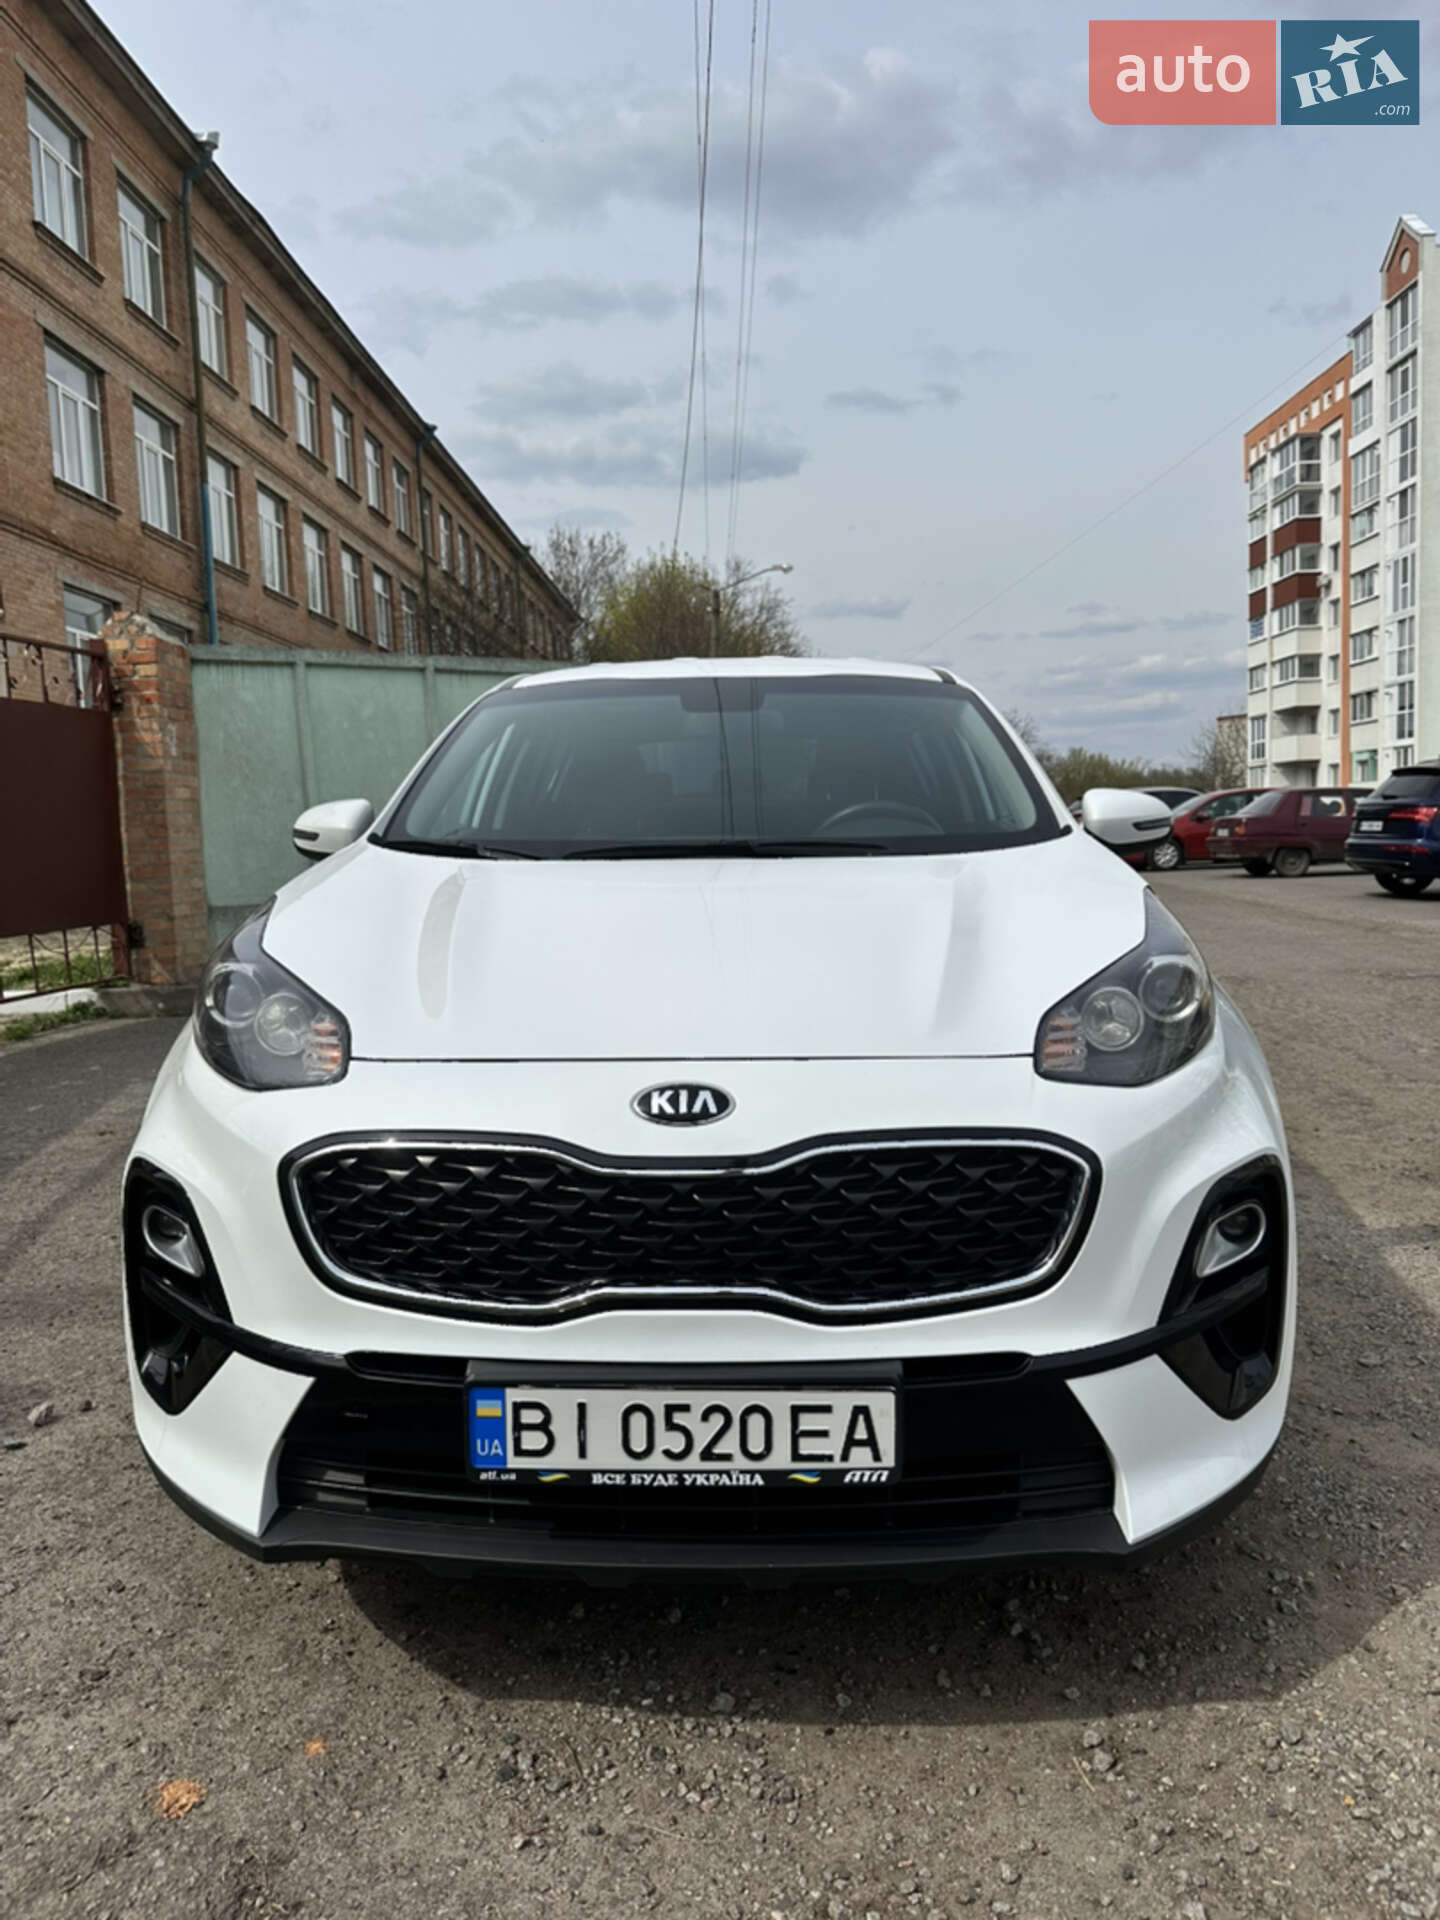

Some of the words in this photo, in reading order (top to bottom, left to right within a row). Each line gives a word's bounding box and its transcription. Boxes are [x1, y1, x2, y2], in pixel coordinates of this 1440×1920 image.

[650, 1089, 717, 1114] KIA
[476, 1438, 503, 1457] UA
[592, 1473, 626, 1485] ВСЕ
[631, 1473, 679, 1487] БУДЕ
[683, 1470, 765, 1486] УКРАЇНА
